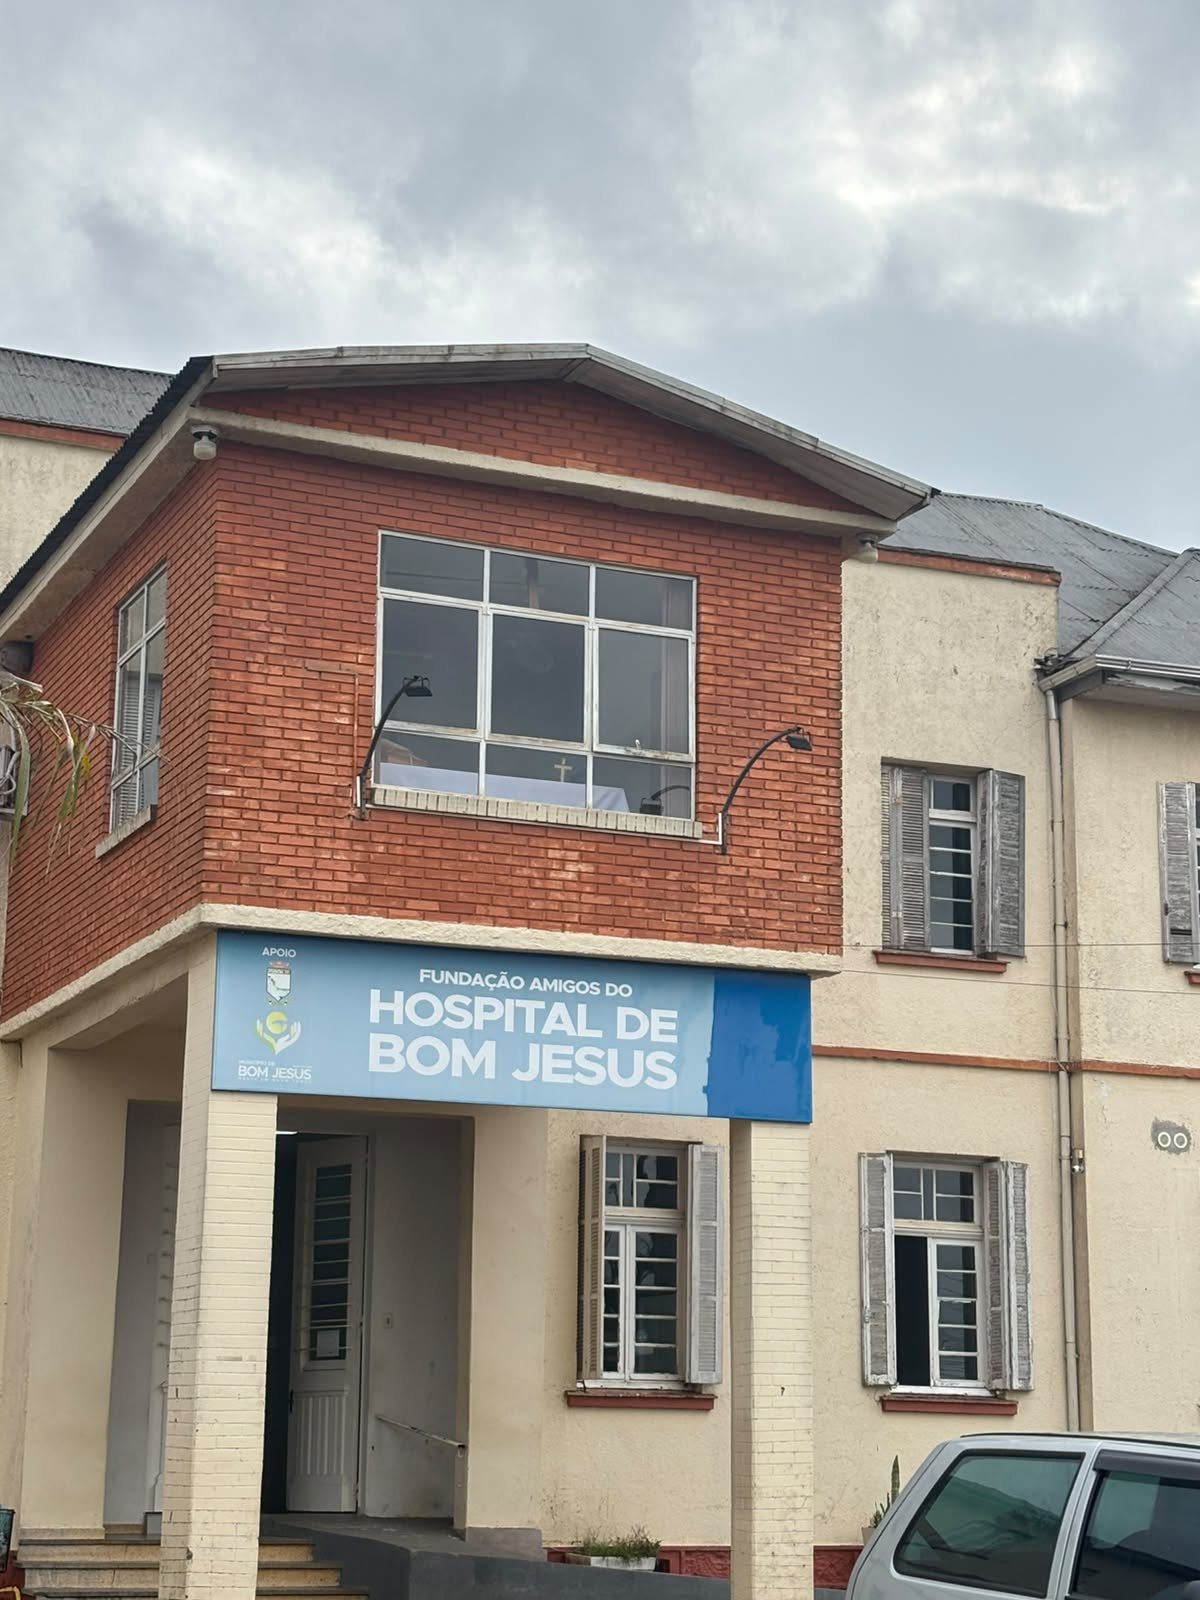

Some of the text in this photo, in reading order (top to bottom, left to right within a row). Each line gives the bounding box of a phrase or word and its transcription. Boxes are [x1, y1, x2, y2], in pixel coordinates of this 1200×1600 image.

[262, 946, 297, 958] APOIO
[419, 968, 633, 998] FUNDAÇÃO AMIGOS DO
[369, 988, 679, 1044] HOSPITAL DE
[238, 1064, 312, 1080] BOM JESUS
[368, 1032, 678, 1090] BOM JESUS
